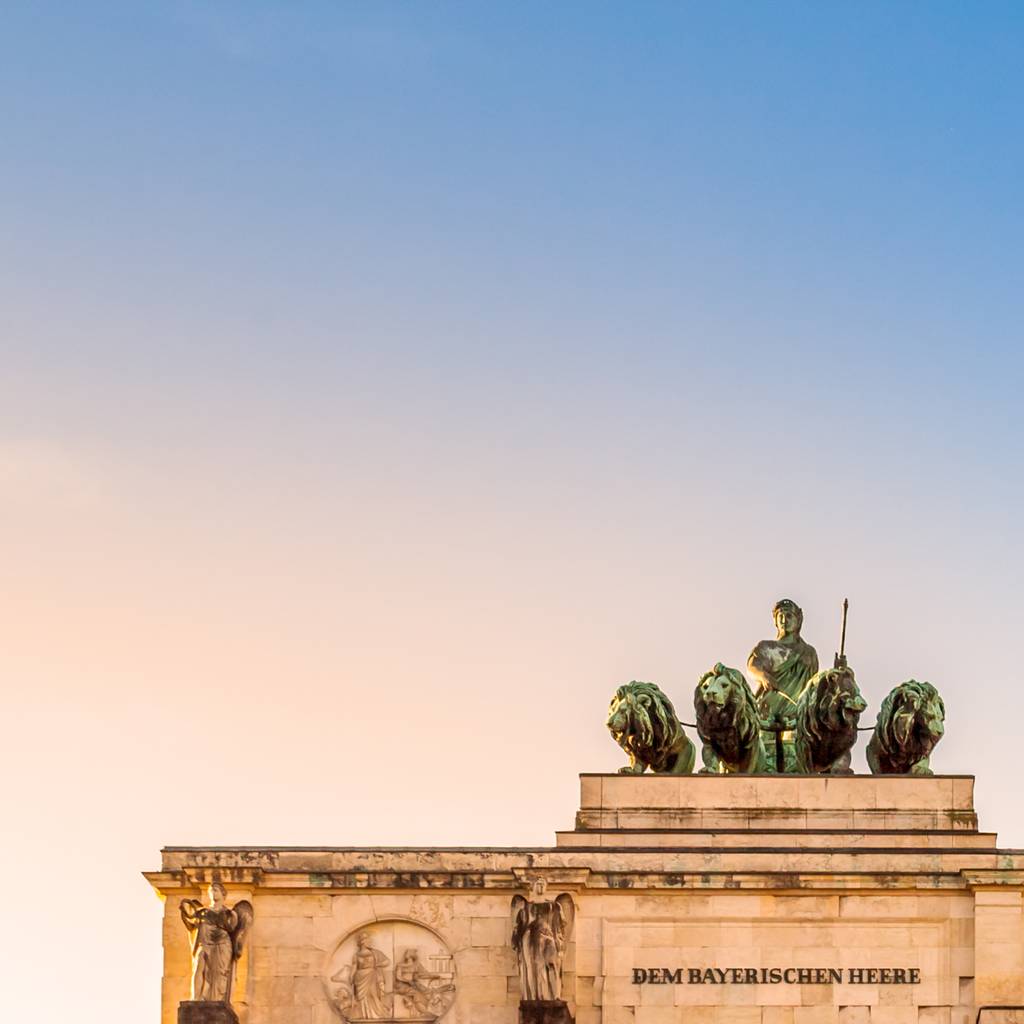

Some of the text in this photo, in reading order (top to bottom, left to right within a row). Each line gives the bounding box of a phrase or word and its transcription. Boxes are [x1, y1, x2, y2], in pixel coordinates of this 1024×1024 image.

[631, 967, 921, 985] DEM BAYERISCHEN HEERE
